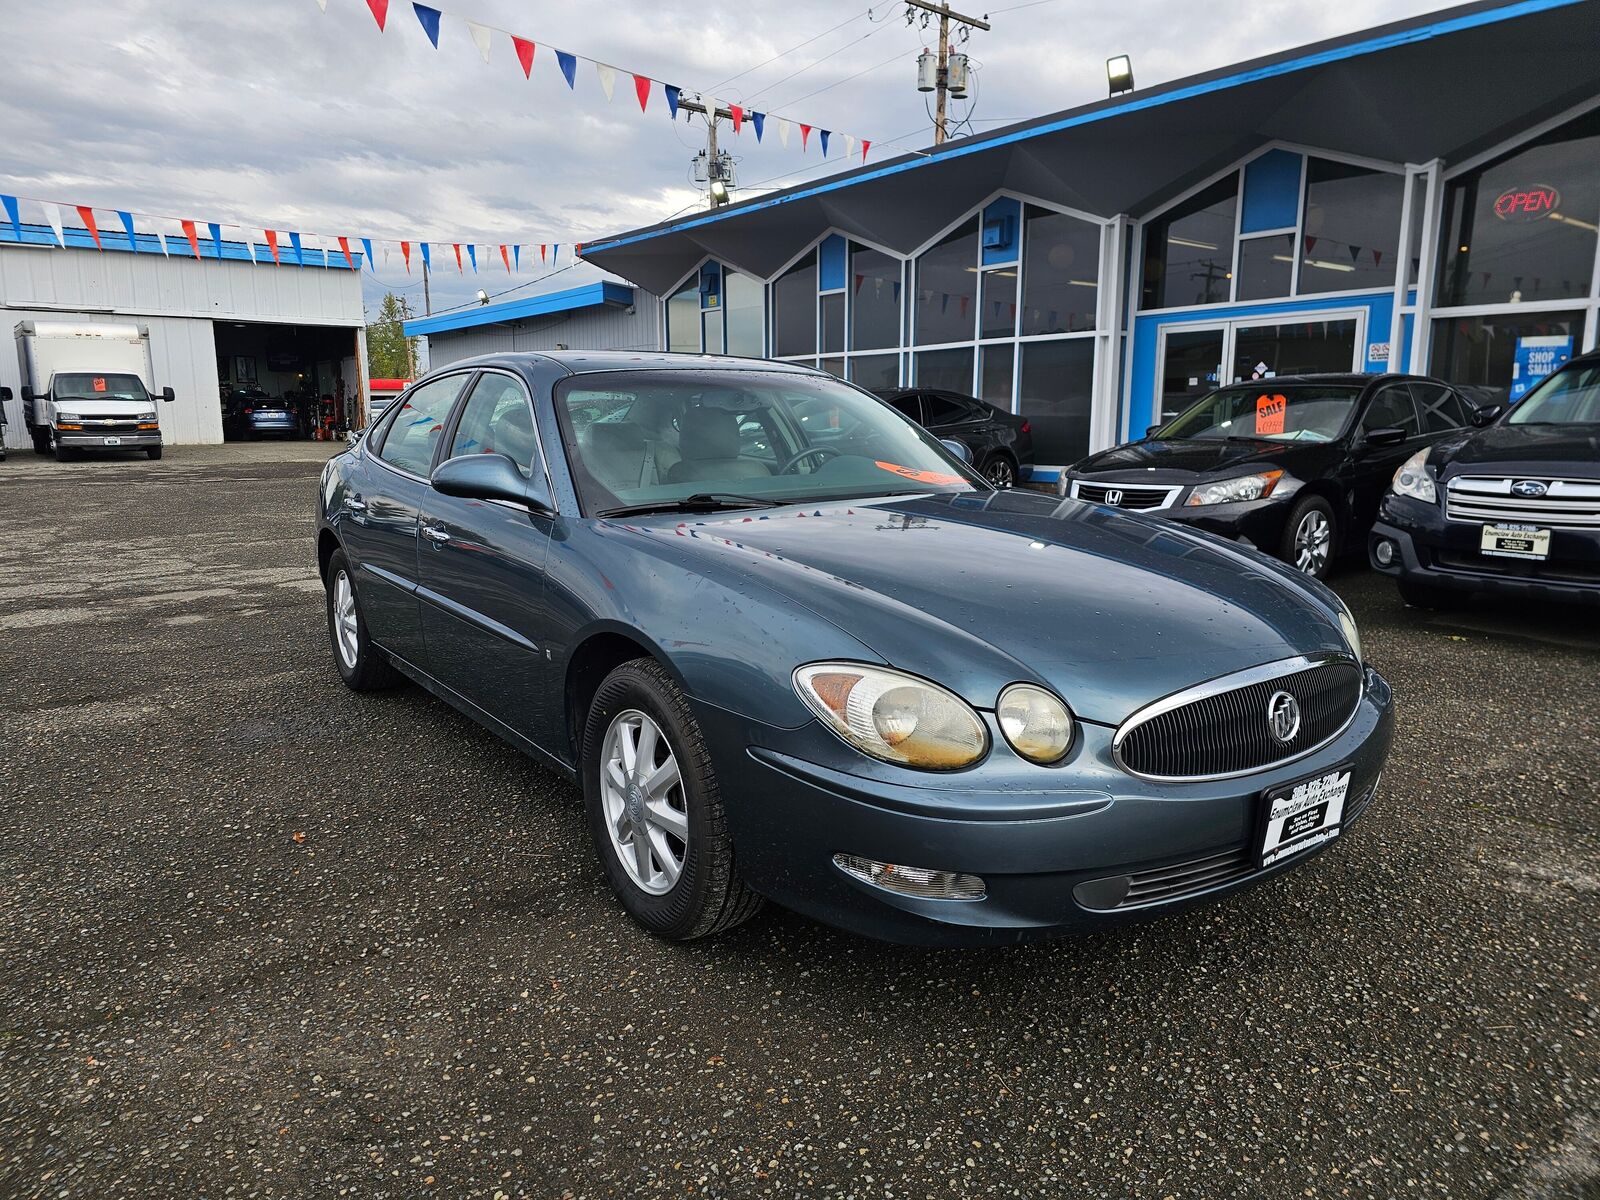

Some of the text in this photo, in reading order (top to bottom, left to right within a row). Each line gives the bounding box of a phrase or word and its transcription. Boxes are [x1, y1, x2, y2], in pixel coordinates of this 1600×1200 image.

[1495, 191, 1555, 214] OPEN
[1528, 351, 1555, 364] SHOP
[1259, 401, 1283, 418] SALE
[1523, 533, 1548, 542] Exchange
[1270, 784, 1347, 819] Enumclaw Auto Exchange
[1307, 808, 1319, 818] First
